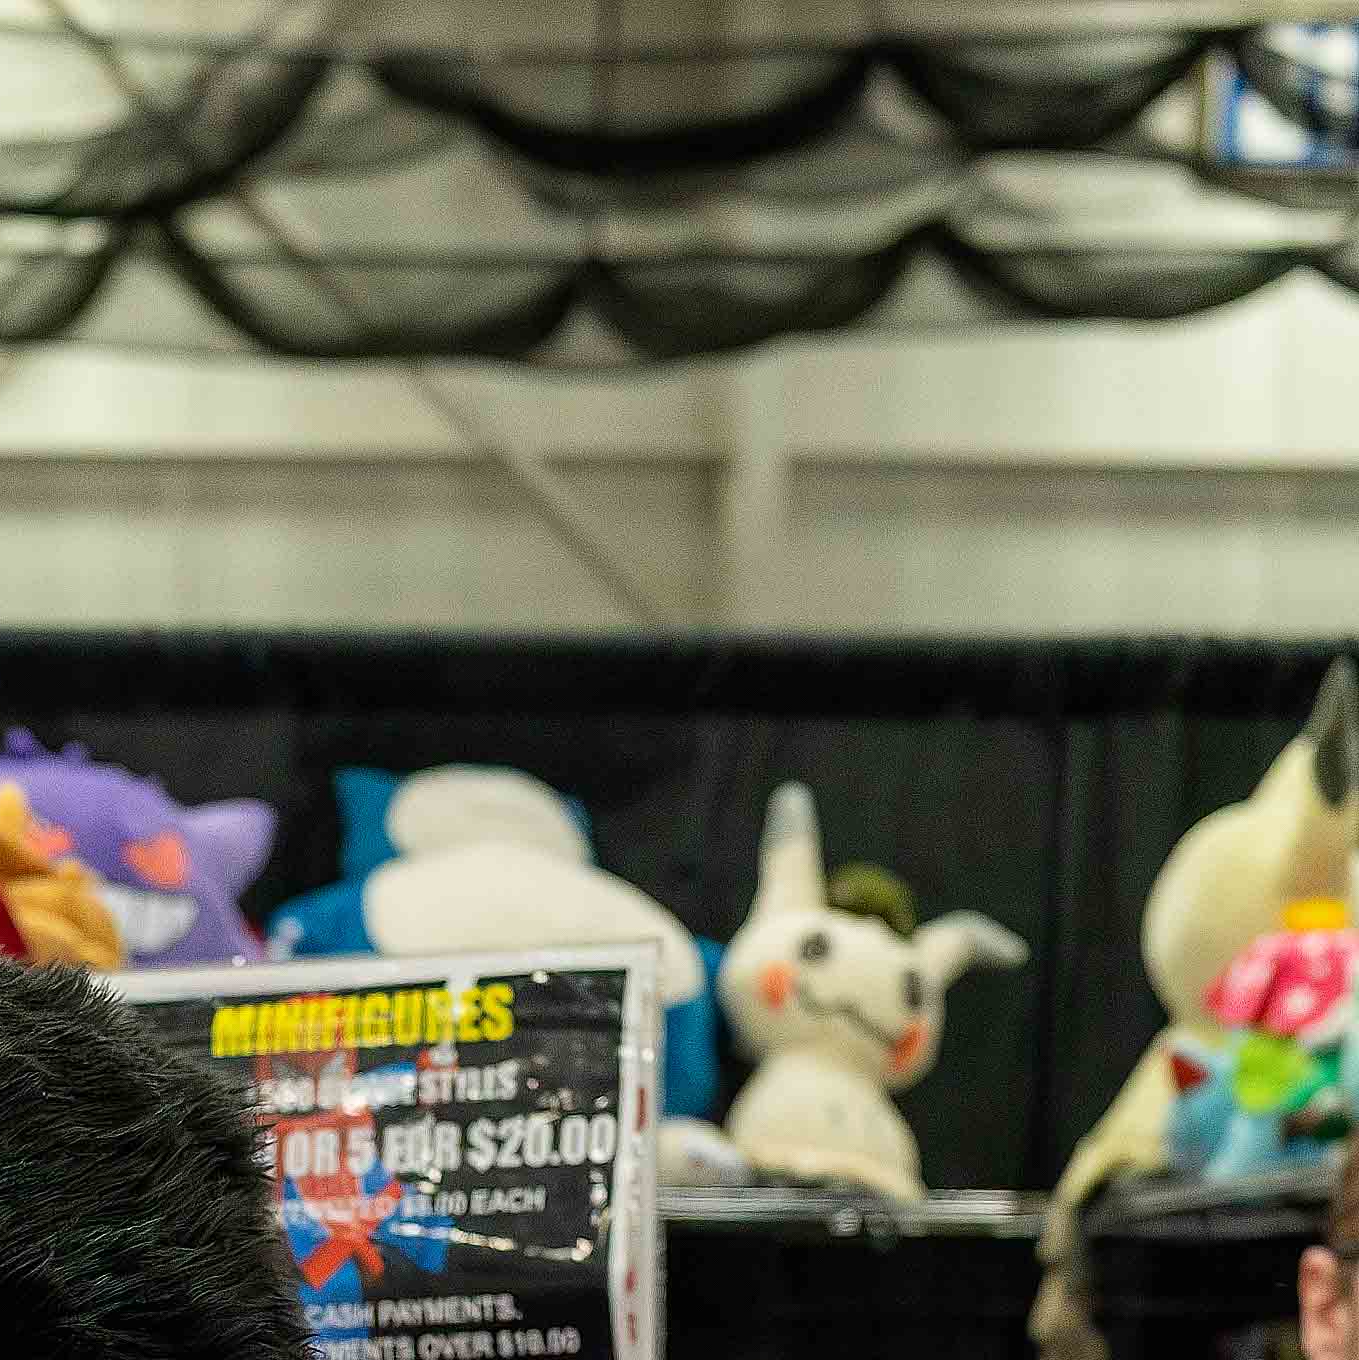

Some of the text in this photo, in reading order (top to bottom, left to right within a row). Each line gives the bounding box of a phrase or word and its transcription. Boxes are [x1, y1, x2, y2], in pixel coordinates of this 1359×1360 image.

[211, 983, 514, 1057] MINIFIGURES
[417, 1060, 520, 1101] STYLES
[283, 1112, 617, 1177] OR 5 FOR $20.00
[470, 1185, 546, 1215] EACH
